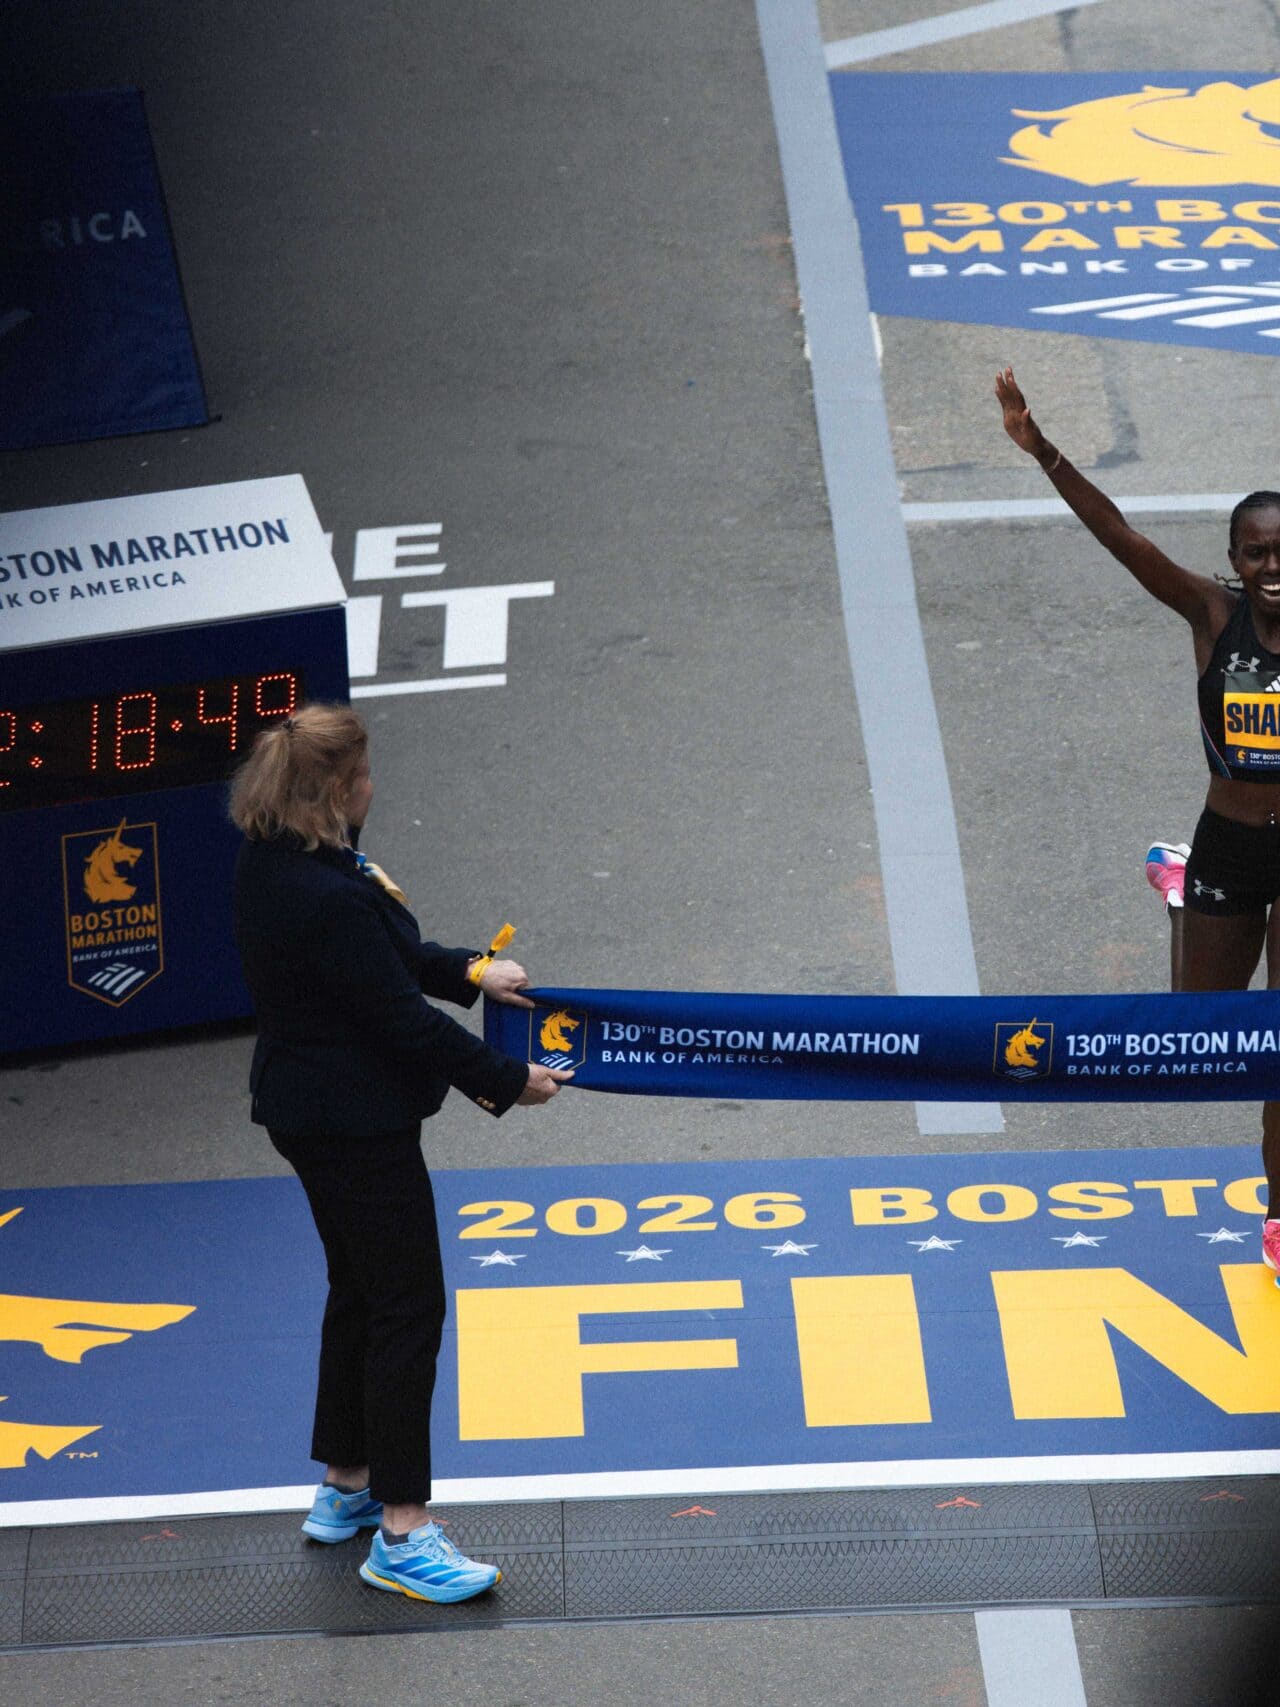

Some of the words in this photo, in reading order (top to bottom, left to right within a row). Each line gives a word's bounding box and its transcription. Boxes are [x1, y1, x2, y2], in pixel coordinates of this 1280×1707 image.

[882, 200, 1132, 227] 130TH
[908, 259, 1130, 277] BANK
[1155, 258, 1254, 272] OF
[90, 518, 291, 569] MARATHON
[29, 587, 60, 605] OF
[70, 571, 187, 600] AMERICA
[71, 904, 156, 933] BOSTON
[72, 924, 157, 949] MARATHON
[73, 952, 99, 962] BANK
[100, 949, 113, 959] OF
[114, 943, 158, 956] AMERICA
[600, 1021, 656, 1042] 130TH
[659, 1027, 764, 1051] BOSTON
[772, 1031, 920, 1056] MARATHON
[1065, 1033, 1121, 1057] 130TH
[1125, 1031, 1229, 1056] BOSTON
[602, 1050, 656, 1064] BANK
[662, 1051, 687, 1064] OF
[692, 1053, 783, 1065] AMERICA
[1067, 1064, 1121, 1075] BANK
[1127, 1064, 1153, 1075] OF
[1157, 1061, 1248, 1075] AMERICA
[457, 1191, 807, 1239] 2026
